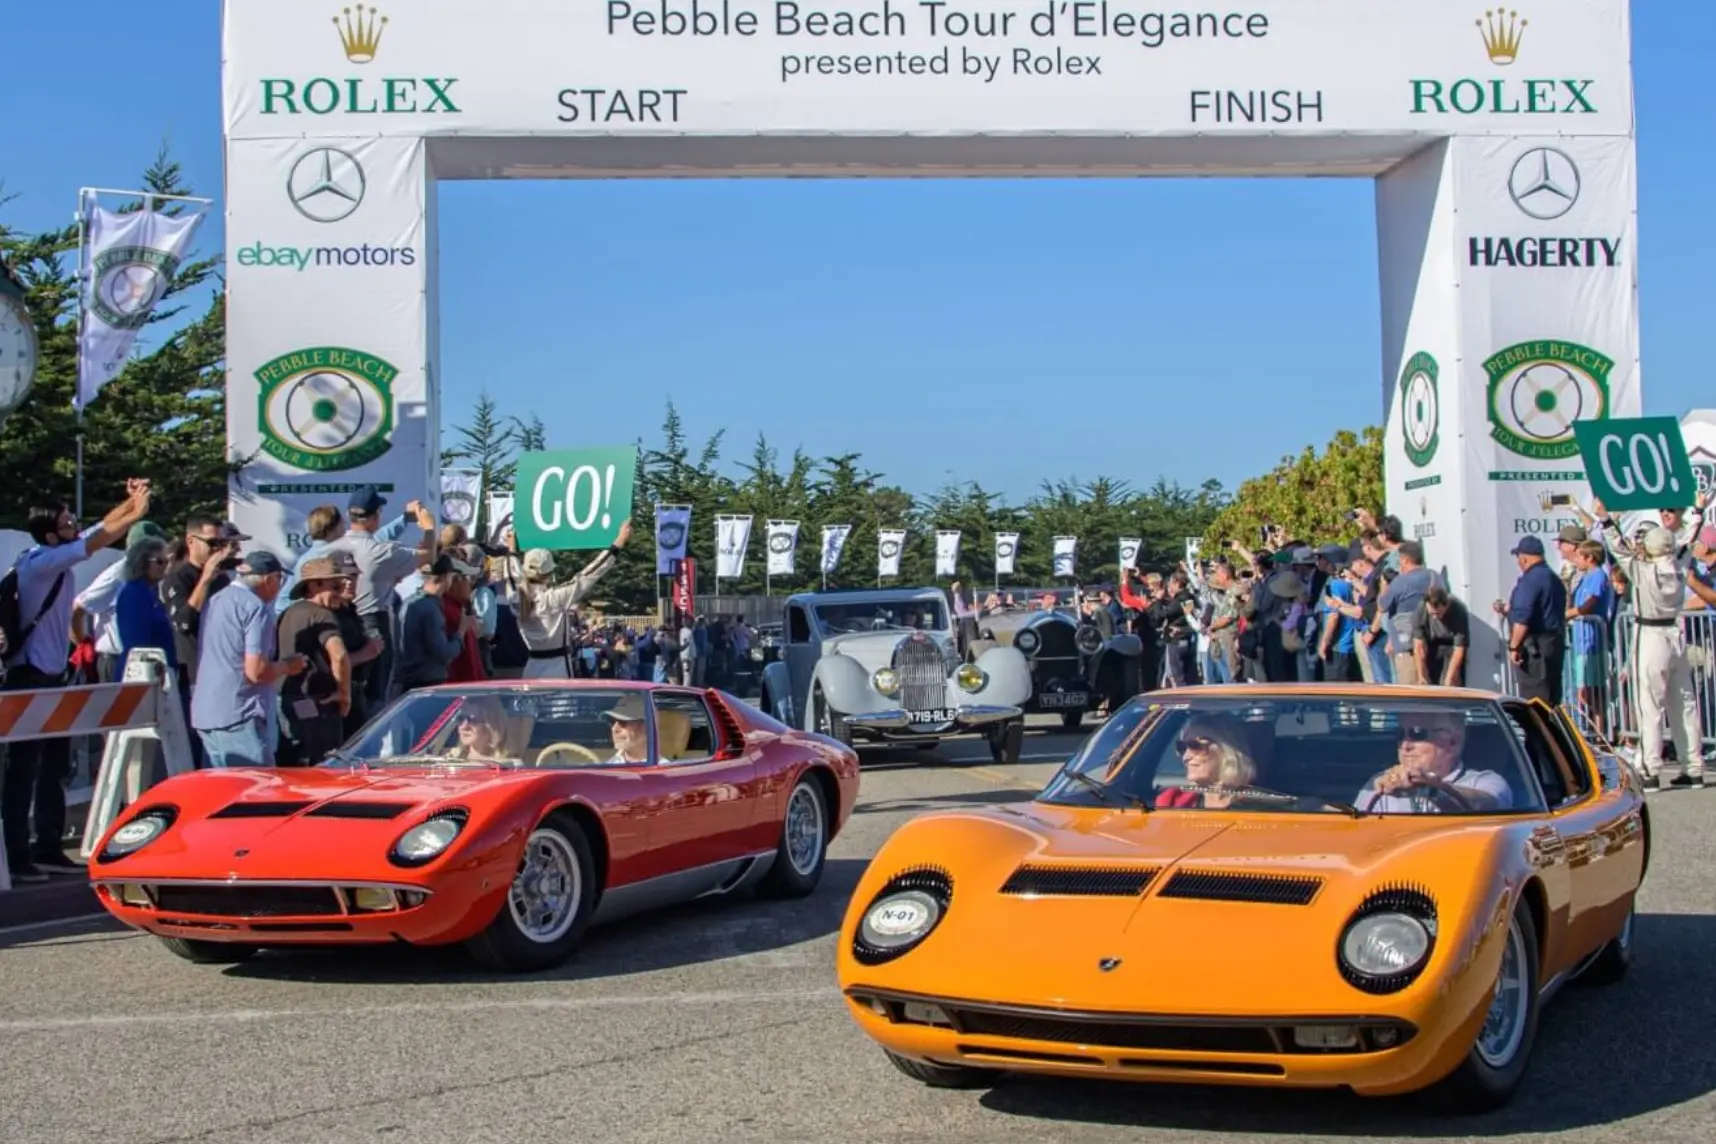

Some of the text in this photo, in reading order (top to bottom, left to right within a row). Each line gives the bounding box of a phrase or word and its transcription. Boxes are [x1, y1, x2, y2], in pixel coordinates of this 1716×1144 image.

[608, 0, 1269, 47] Pebble Beach Tour d'Elegance
[782, 46, 1102, 82] presented by Rolex
[259, 77, 462, 114] ROLEX
[557, 89, 688, 123] START
[1191, 90, 1323, 122] FINISH
[1409, 79, 1598, 114] ROLEX
[1469, 236, 1621, 267] HAGERTY
[259, 350, 392, 383] PEBBLE BEACH
[1487, 342, 1608, 375] PEBBLE BEACH
[1499, 471, 1576, 481] PRESENTED
[1599, 432, 1680, 495] GO!
[532, 464, 616, 532] GO!
[881, 909, 914, 921] N-01
